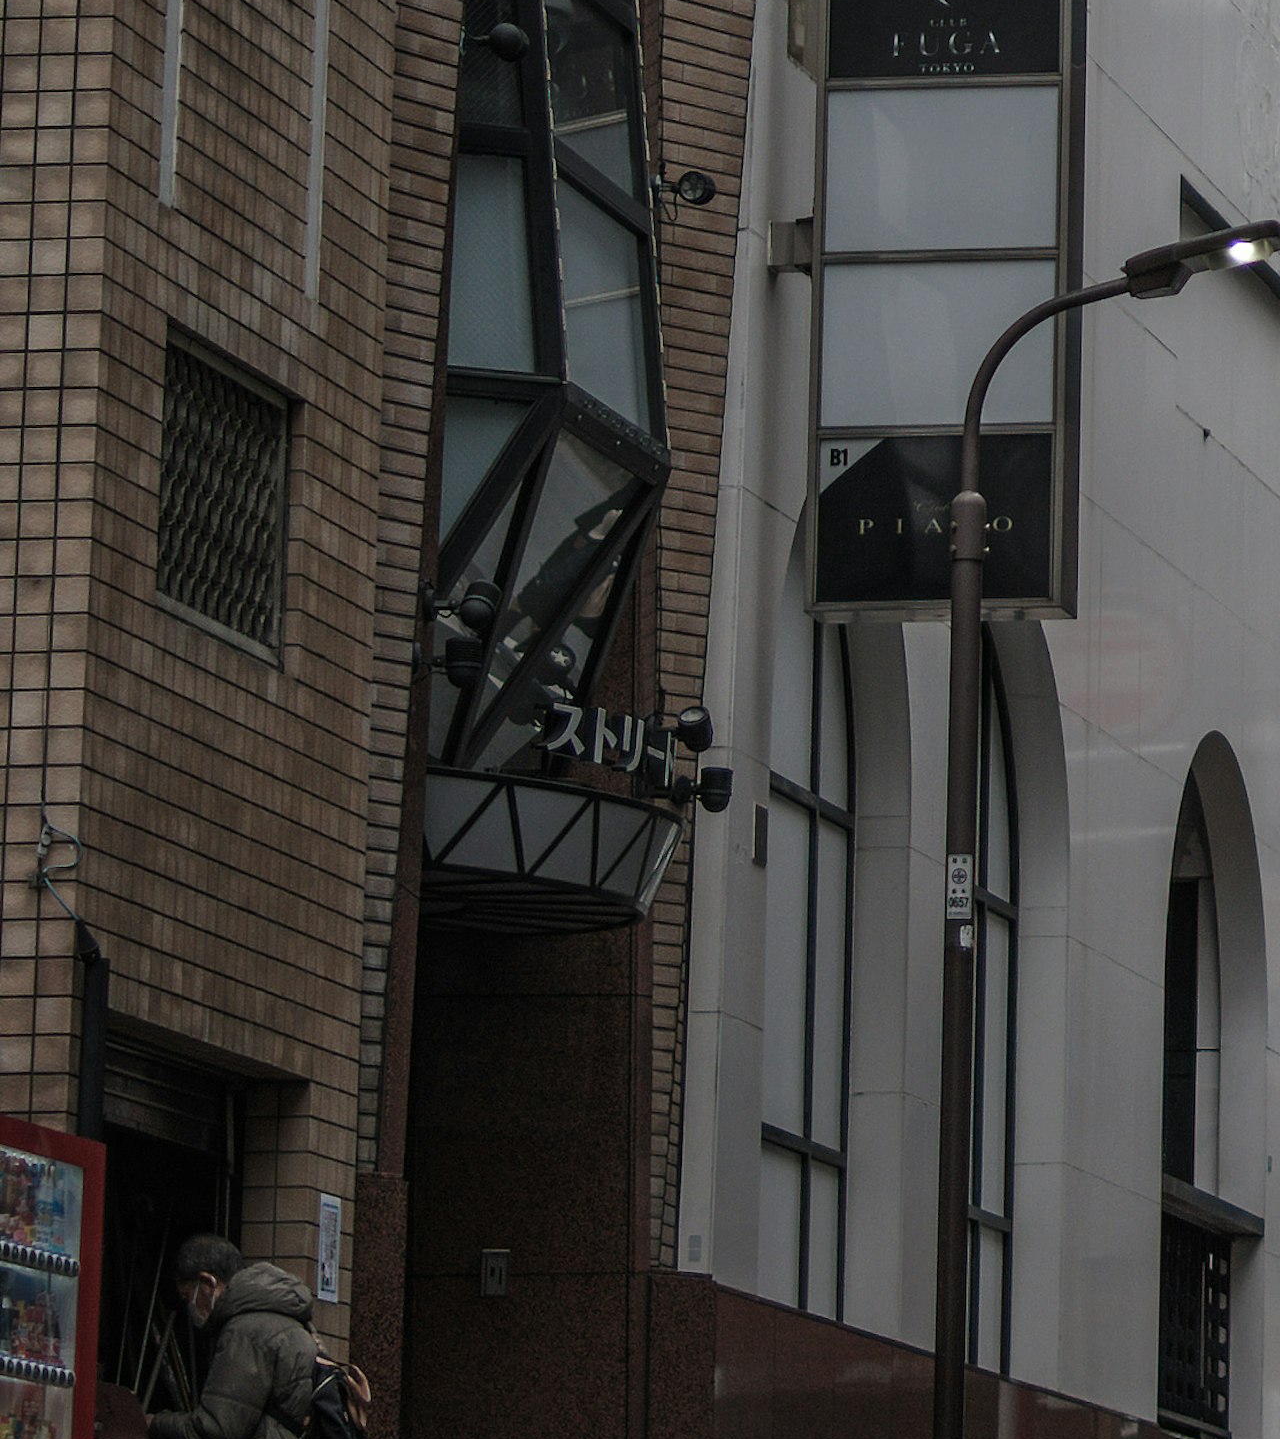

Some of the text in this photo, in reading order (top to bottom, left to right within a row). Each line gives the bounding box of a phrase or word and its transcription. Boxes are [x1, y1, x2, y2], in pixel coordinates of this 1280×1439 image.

[892, 31, 1001, 57] FUGA
[920, 63, 976, 74] TOKYO
[830, 449, 849, 466] B1
[858, 515, 1015, 536] PIAO
